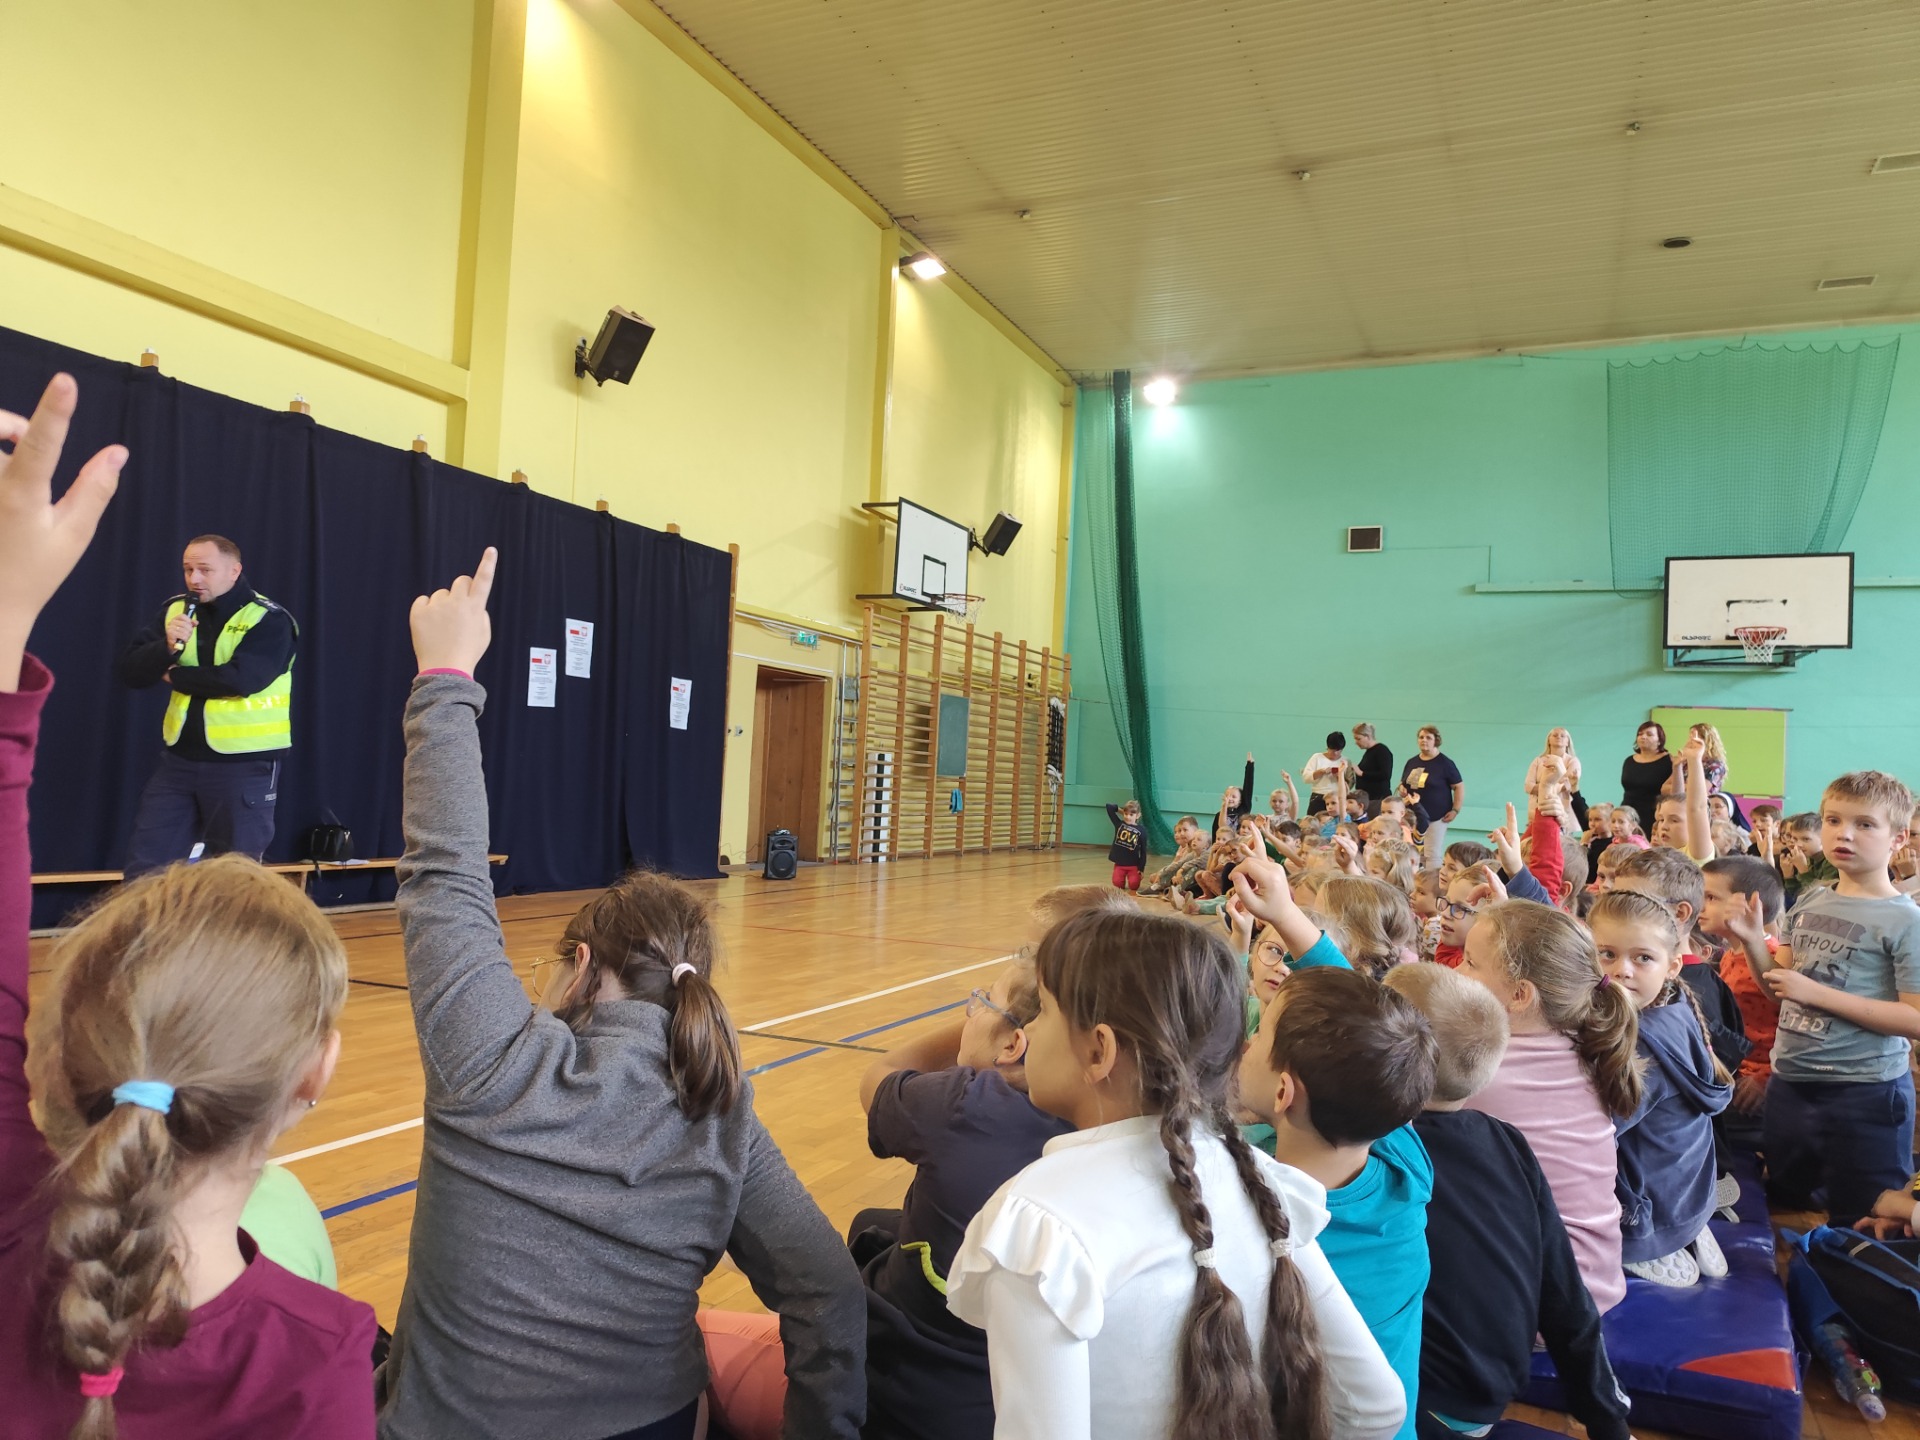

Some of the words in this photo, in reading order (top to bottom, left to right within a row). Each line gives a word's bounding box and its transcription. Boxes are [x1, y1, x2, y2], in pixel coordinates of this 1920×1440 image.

[1795, 914, 1804, 927] A
[1809, 915, 1846, 931] DAY
[1792, 933, 1858, 961] ITHOUT
[1808, 960, 1839, 984] IS
